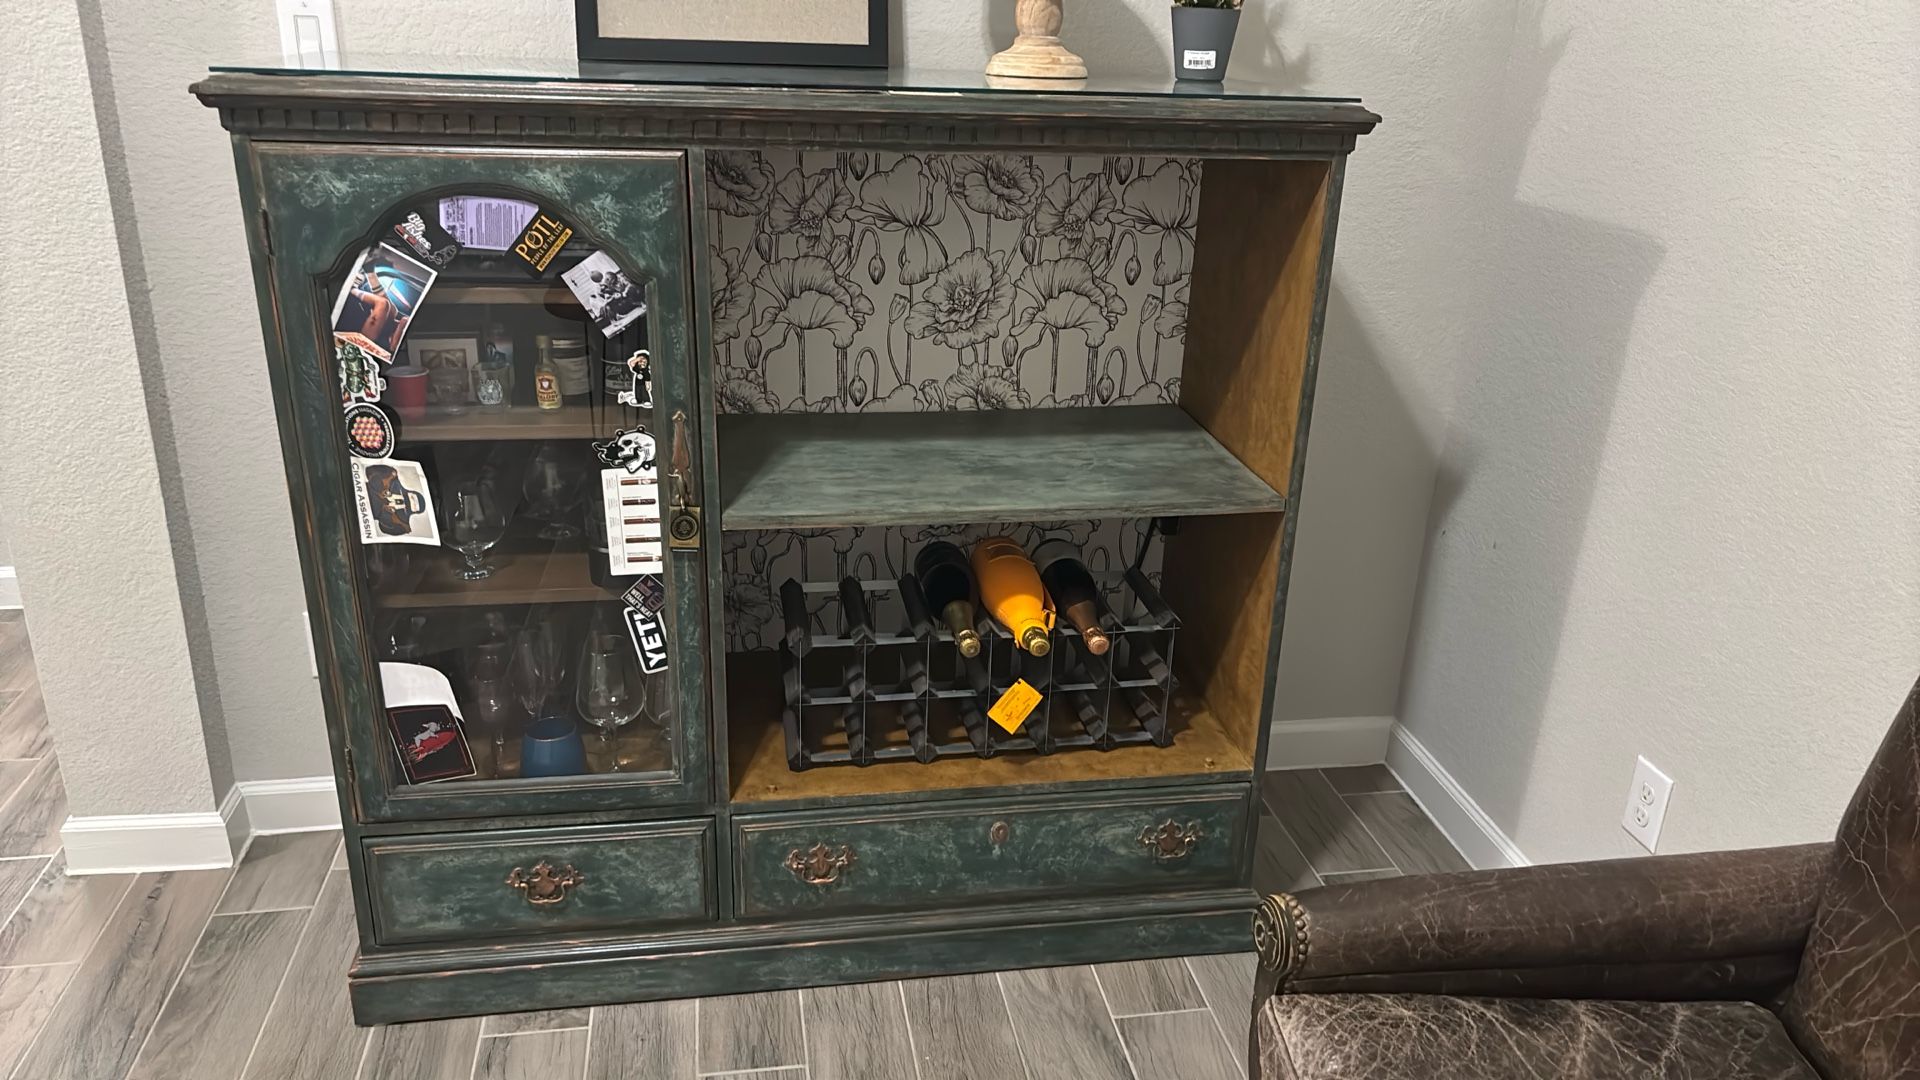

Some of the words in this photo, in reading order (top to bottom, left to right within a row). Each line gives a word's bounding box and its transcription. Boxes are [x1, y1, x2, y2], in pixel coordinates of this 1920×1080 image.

[407, 212, 425, 233] Big
[515, 215, 560, 262] POTL
[352, 463, 363, 491] CIGAR
[358, 495, 372, 538] ASSASSIN
[639, 605, 654, 619] NEAT
